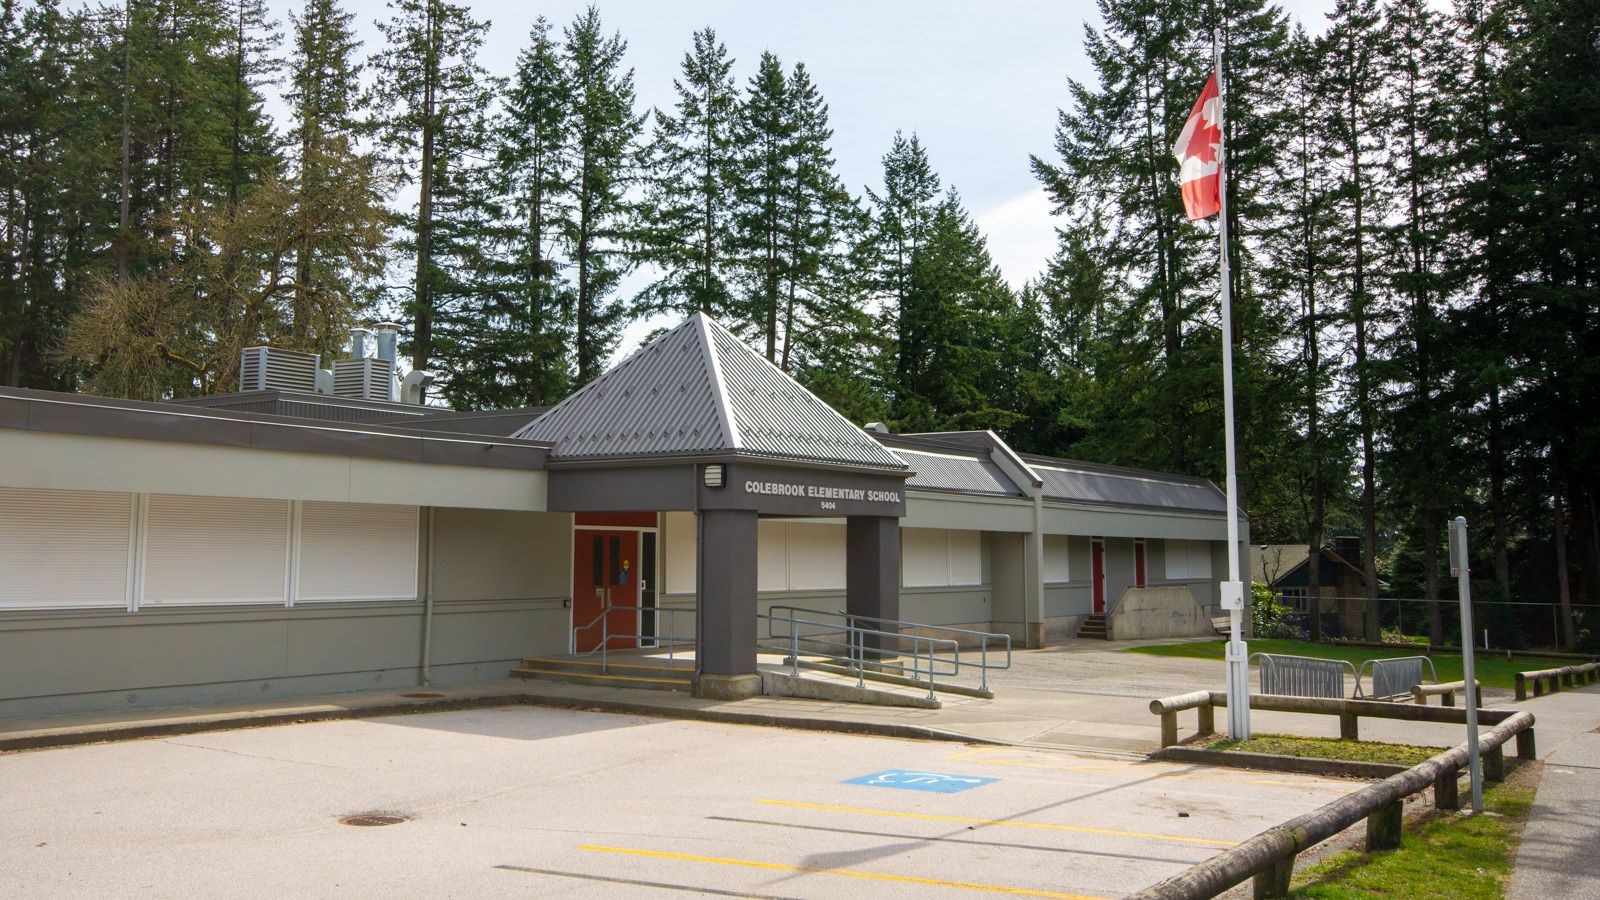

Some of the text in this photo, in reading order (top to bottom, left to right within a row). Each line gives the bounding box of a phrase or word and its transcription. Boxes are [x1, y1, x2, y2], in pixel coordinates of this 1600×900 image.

[745, 481, 900, 502] COLEBROOK ELEMENTARY SCHOOL
[821, 501, 836, 510] 5404
